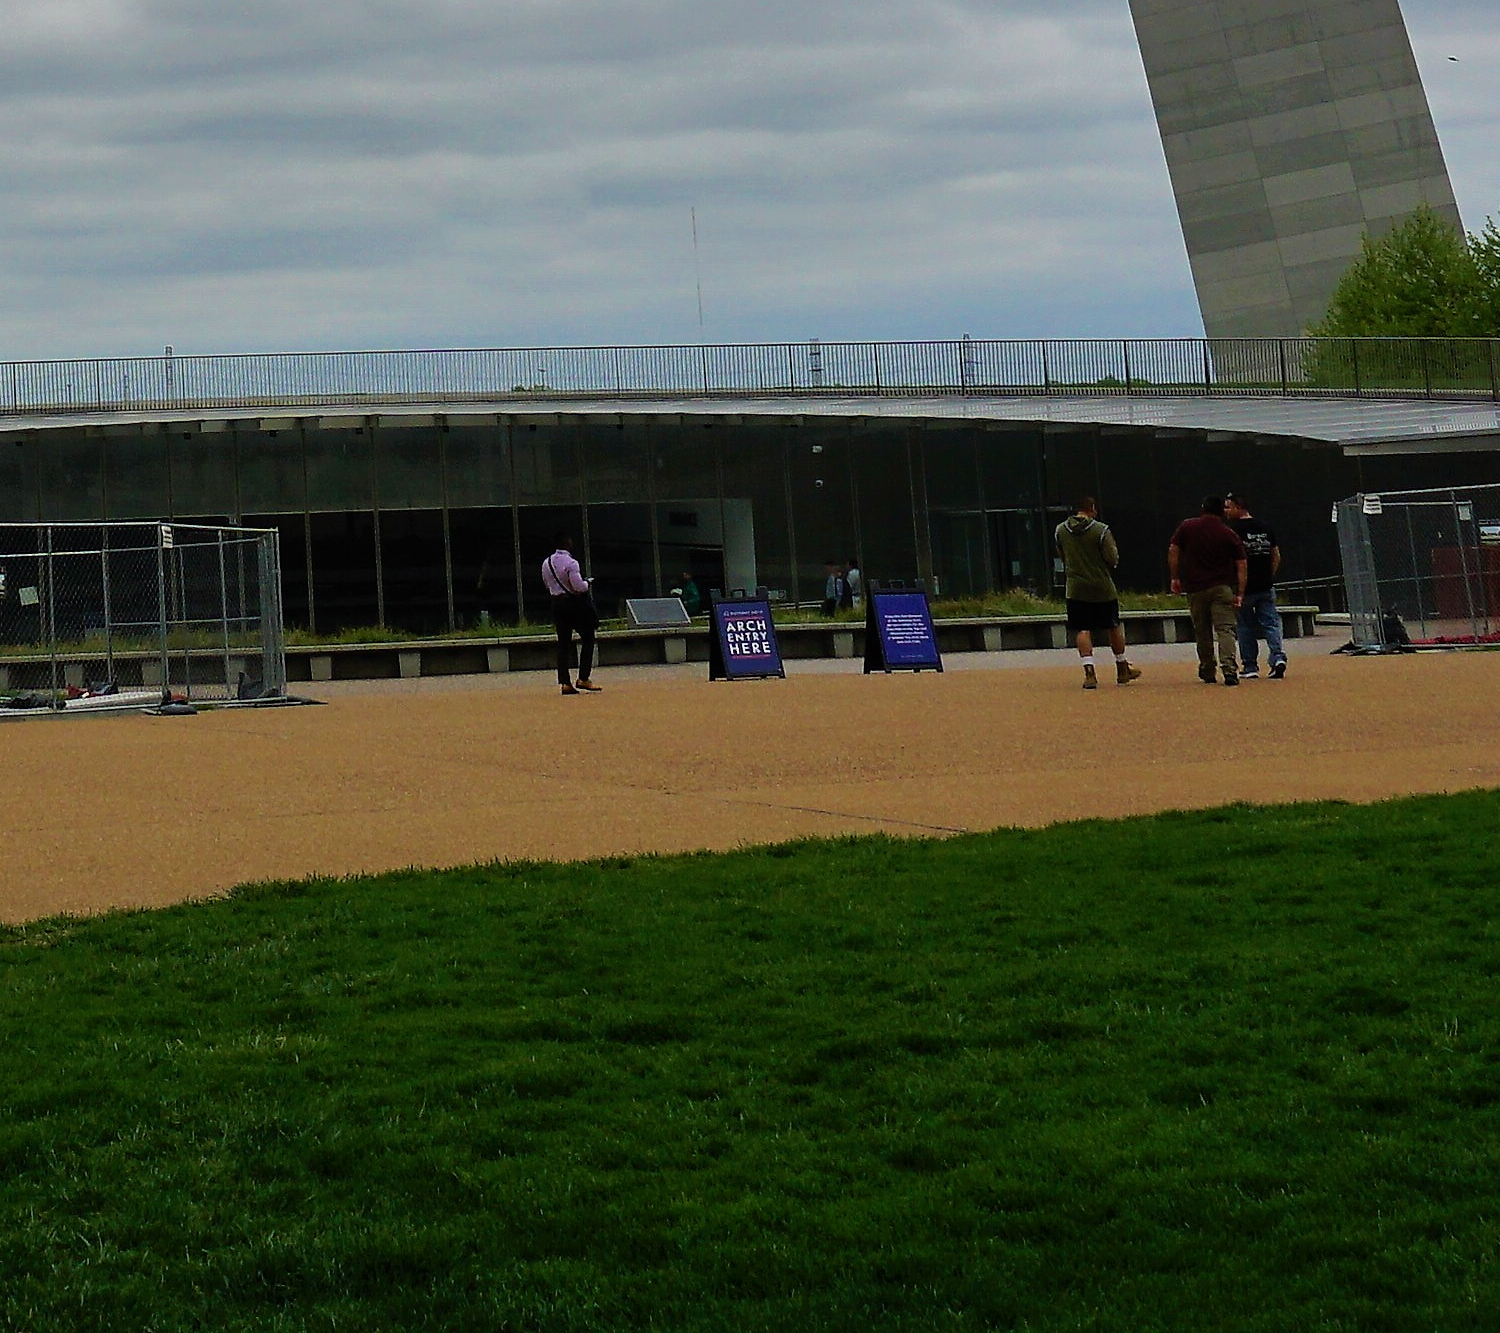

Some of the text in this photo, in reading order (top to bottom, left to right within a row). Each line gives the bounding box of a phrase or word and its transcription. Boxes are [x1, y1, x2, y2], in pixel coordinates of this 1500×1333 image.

[726, 620, 767, 632] ARCH
[727, 631, 767, 642] ENTRY
[729, 641, 771, 655] HERE
